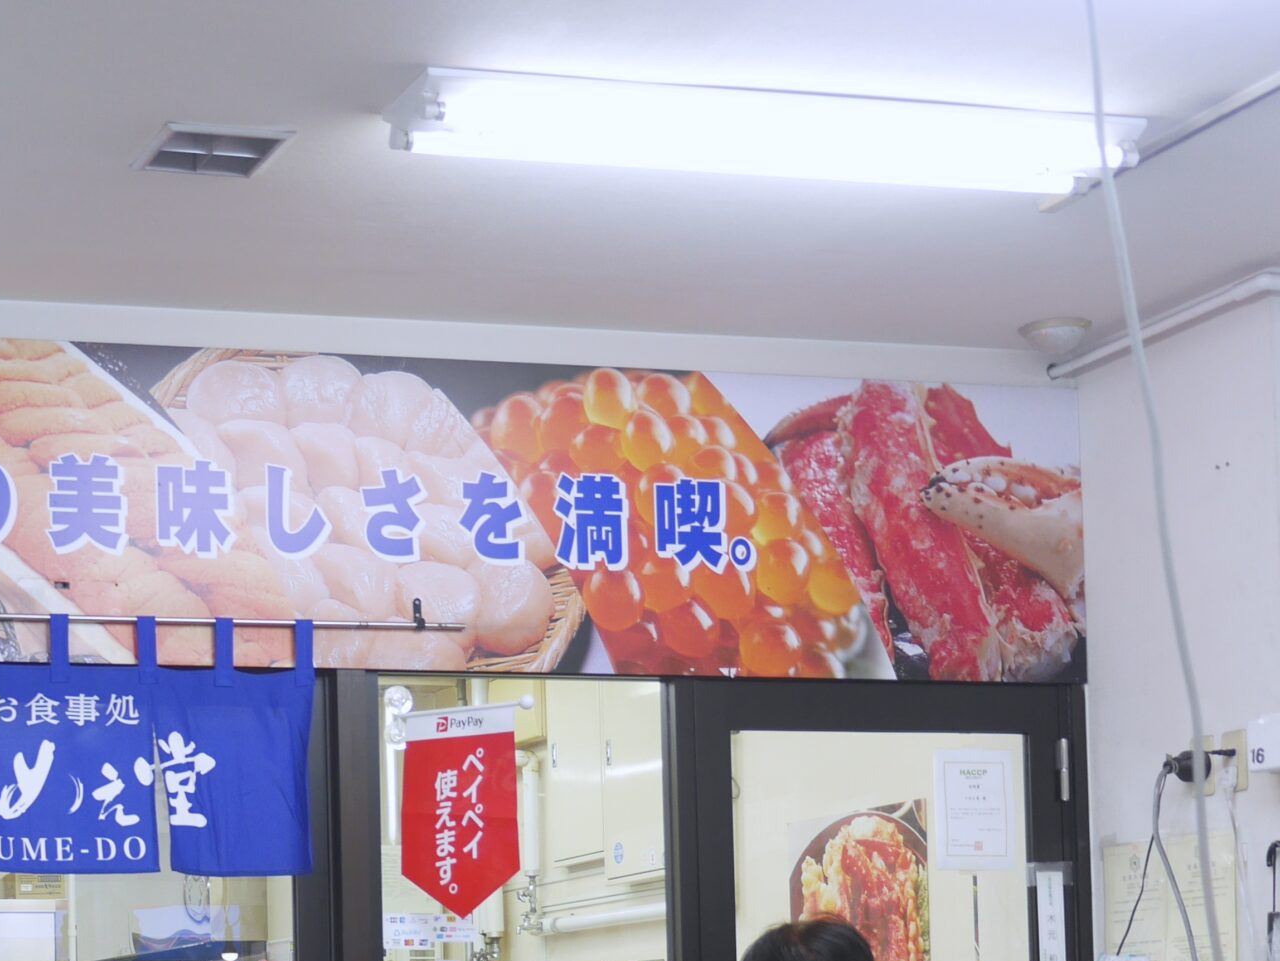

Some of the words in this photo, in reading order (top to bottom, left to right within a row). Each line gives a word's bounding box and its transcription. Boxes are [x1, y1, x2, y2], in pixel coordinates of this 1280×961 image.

[449, 716, 484, 730] PayPay
[1250, 746, 1265, 765] 16
[434, 769, 458, 895] 使えます。
[462, 747, 485, 860] ペイペイ
